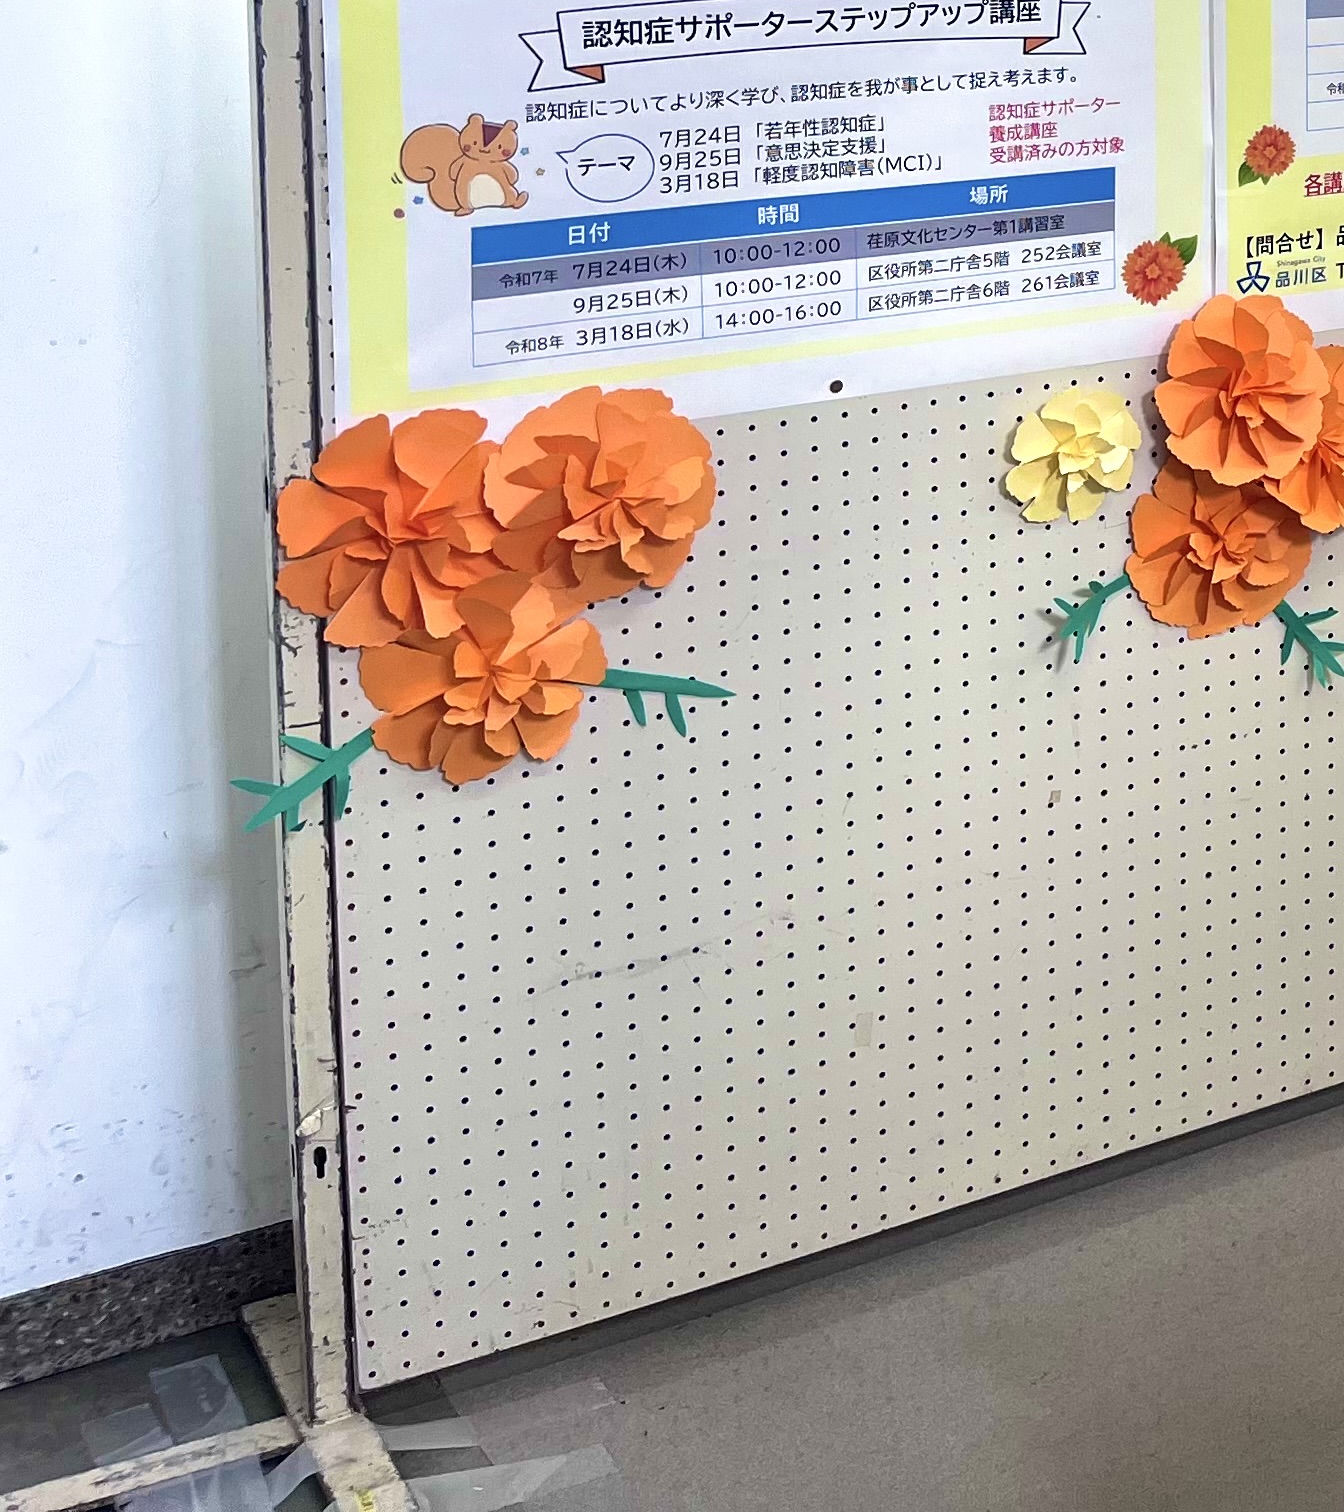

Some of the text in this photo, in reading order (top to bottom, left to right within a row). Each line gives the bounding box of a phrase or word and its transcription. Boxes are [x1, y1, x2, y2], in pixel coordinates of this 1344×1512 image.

[525, 66, 1078, 123] 認知症についてより深く学び、認知症を我が事として捉え考えます。
[988, 97, 1121, 121] 認知症サポーター
[659, 115, 885, 149] 7月24日 「若年性認知症」
[988, 123, 1059, 144] 養成講座
[577, 154, 636, 176] テーマ
[659, 137, 886, 172] 9月25日 「意思決定支援」
[989, 137, 1125, 165] 受講済みの方対象
[659, 155, 943, 194] 3月18日 「軽度認知障害(MCI)」
[567, 185, 1009, 246] 日付 時間 場所
[499, 214, 1066, 288] 令和7年 7月24日(木) 10:00-12:00 荏原文化センター第1講習室
[1246, 228, 1323, 259] 【問合せ】
[1275, 267, 1327, 288] 品川区
[1276, 258, 1311, 268] Shinagawa
[505, 270, 1100, 355] 令和8年 3月18日(水) 14:00-16:00 区役所第二庁舎6階 261会議室
